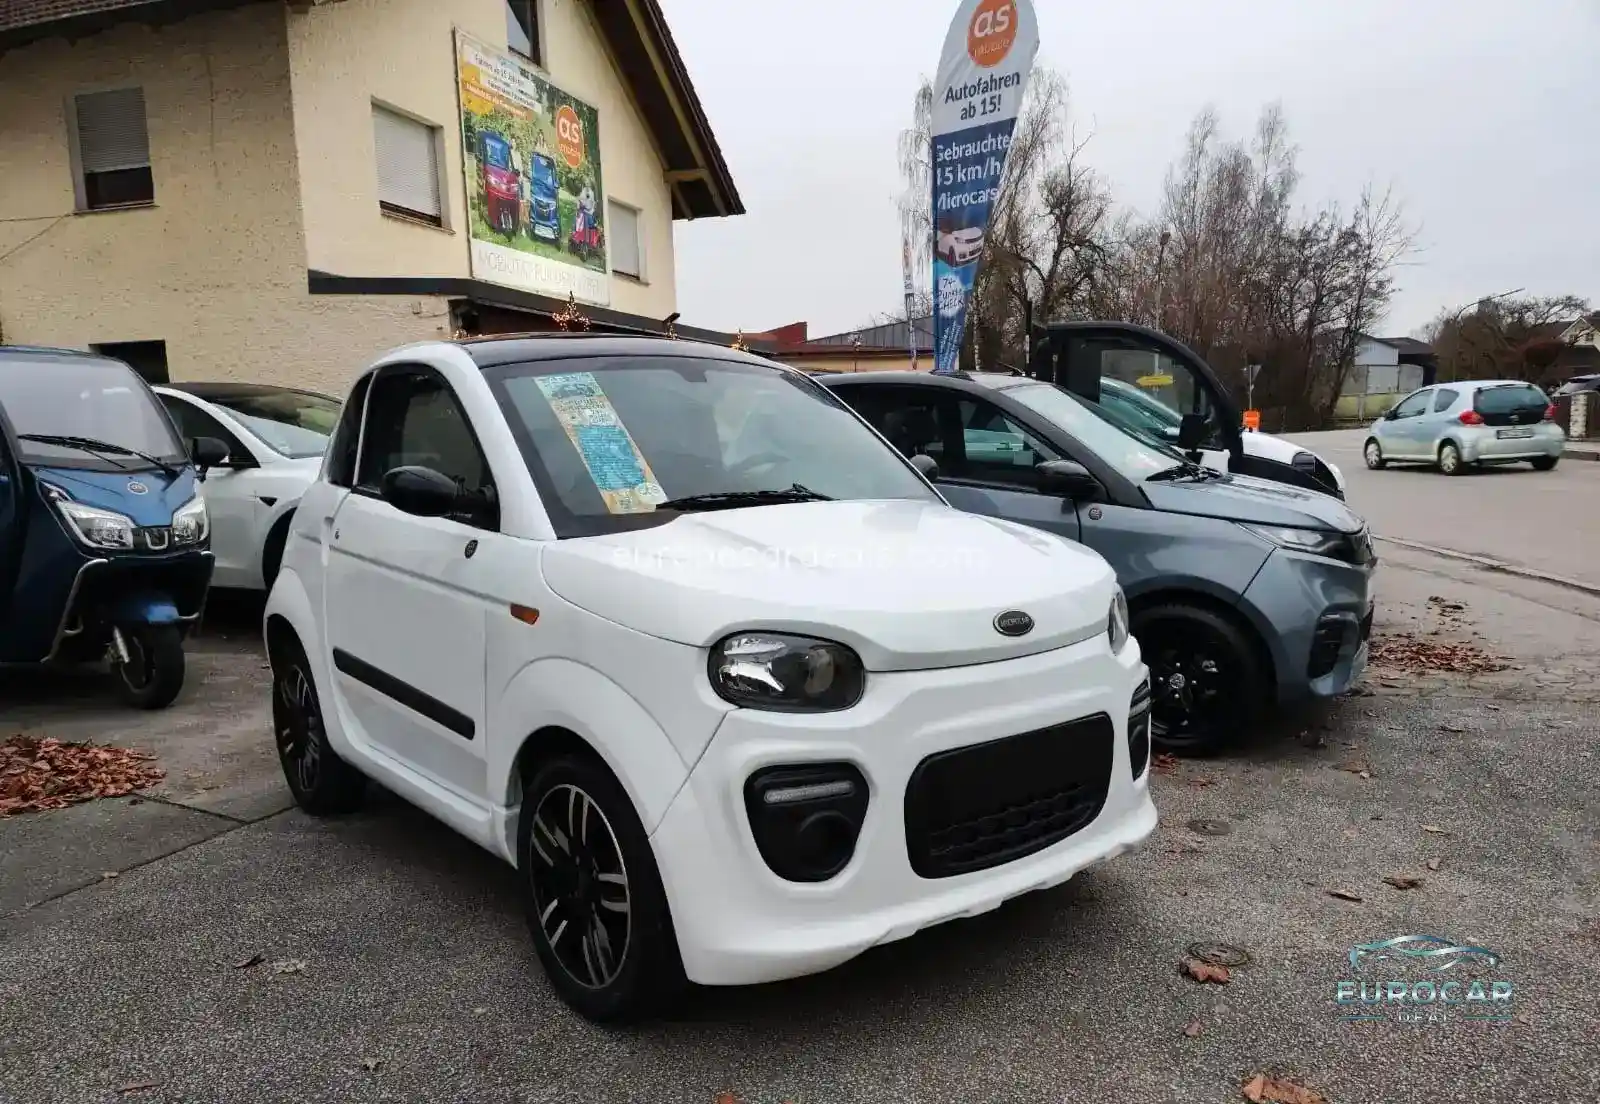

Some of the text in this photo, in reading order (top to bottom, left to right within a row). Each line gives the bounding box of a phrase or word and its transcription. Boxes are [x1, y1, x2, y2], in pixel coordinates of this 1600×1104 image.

[974, 4, 1011, 38] as
[944, 71, 1020, 104] Autofahren
[960, 94, 1002, 121] ab 15!
[558, 116, 580, 143] as
[957, 156, 1001, 182] km/h
